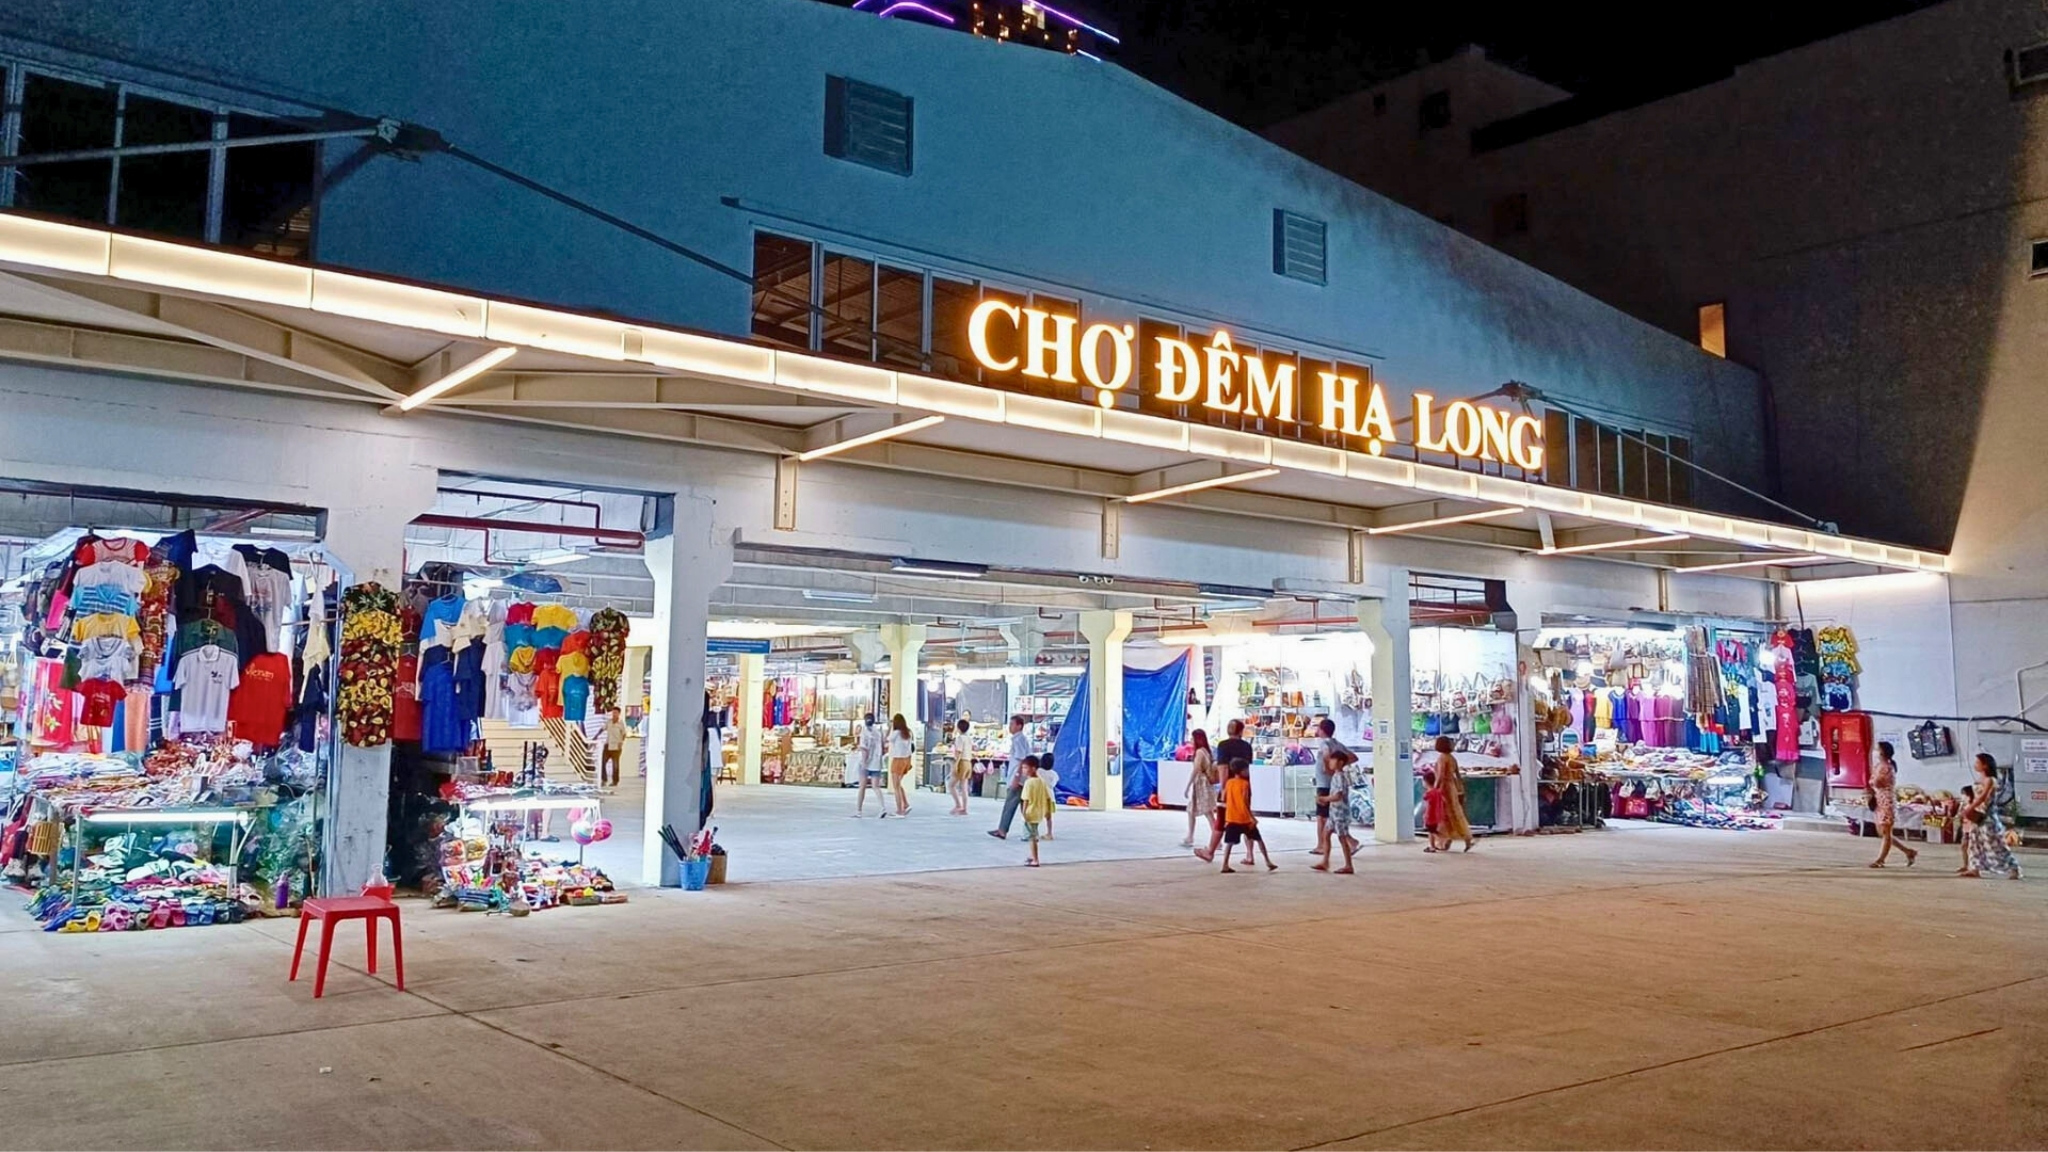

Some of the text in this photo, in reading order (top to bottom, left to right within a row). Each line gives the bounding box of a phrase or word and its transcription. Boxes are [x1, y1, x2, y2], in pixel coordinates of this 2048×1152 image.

[968, 300, 1543, 470] CHỢ ĐÊM HẠ LONG
